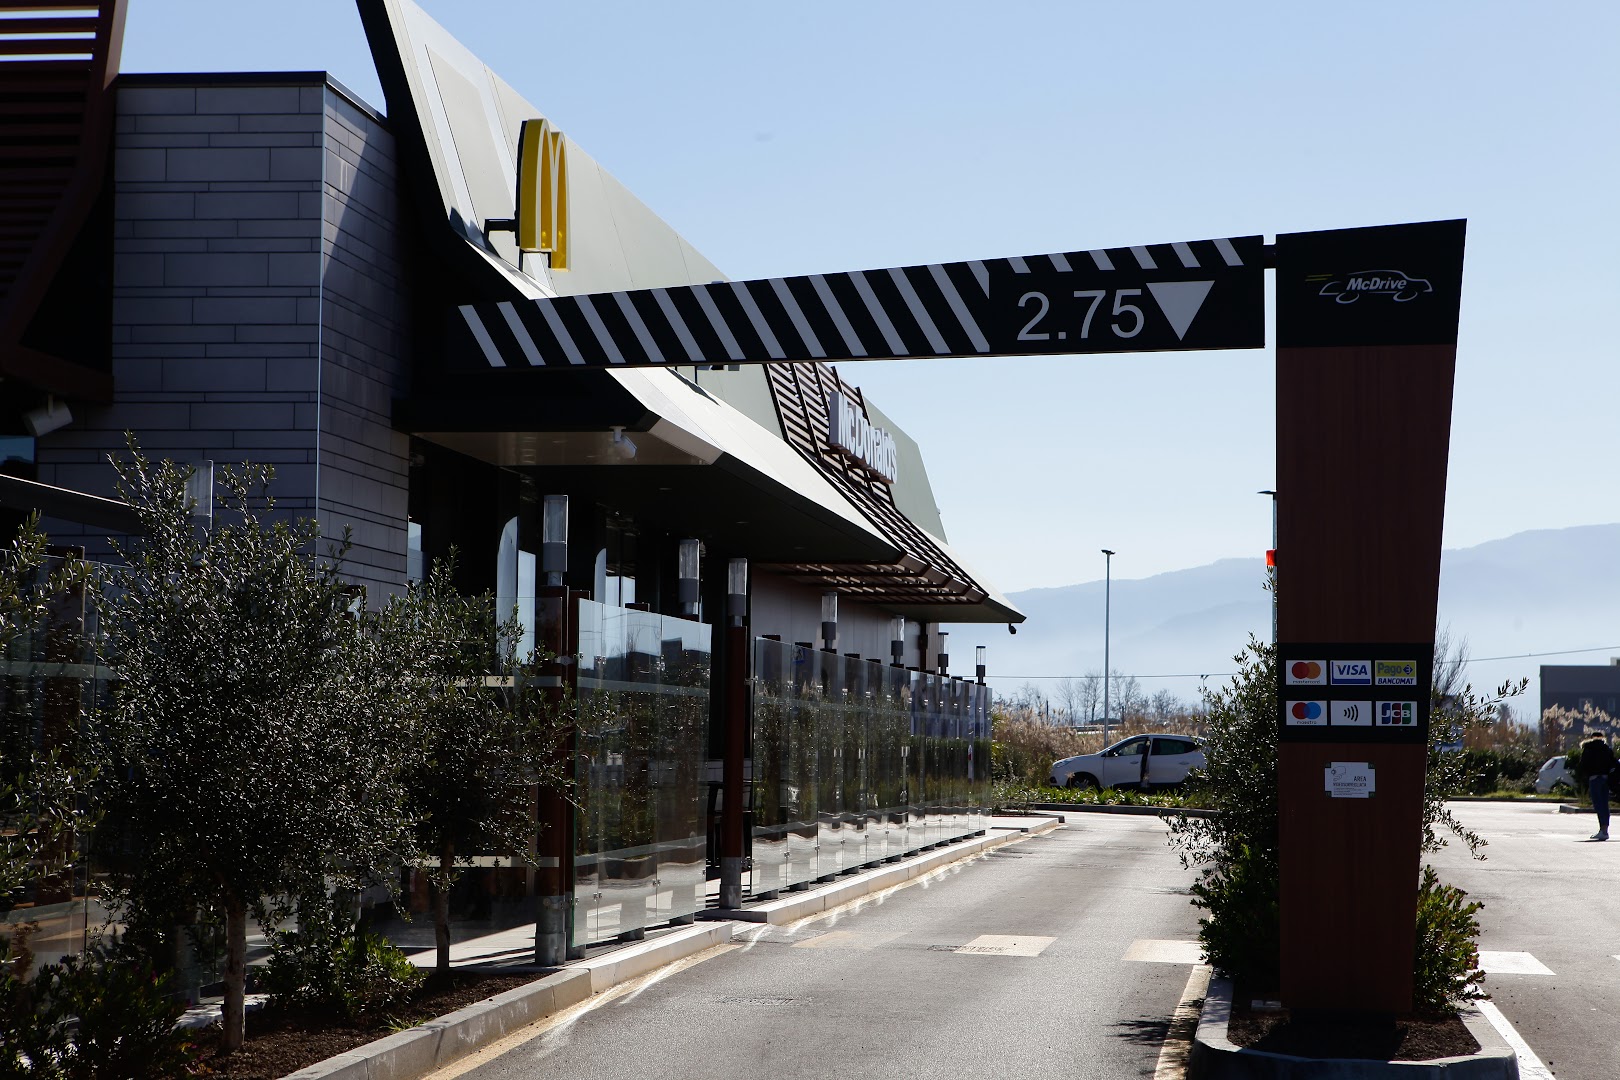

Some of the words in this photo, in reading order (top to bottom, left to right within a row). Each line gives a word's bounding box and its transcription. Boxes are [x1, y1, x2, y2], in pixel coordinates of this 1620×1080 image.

[1346, 277, 1407, 291] McDrive
[1016, 288, 1145, 342] 2.75
[1335, 664, 1368, 676] VISA
[1377, 662, 1402, 677] Pago
[1381, 709, 1410, 718] JCB
